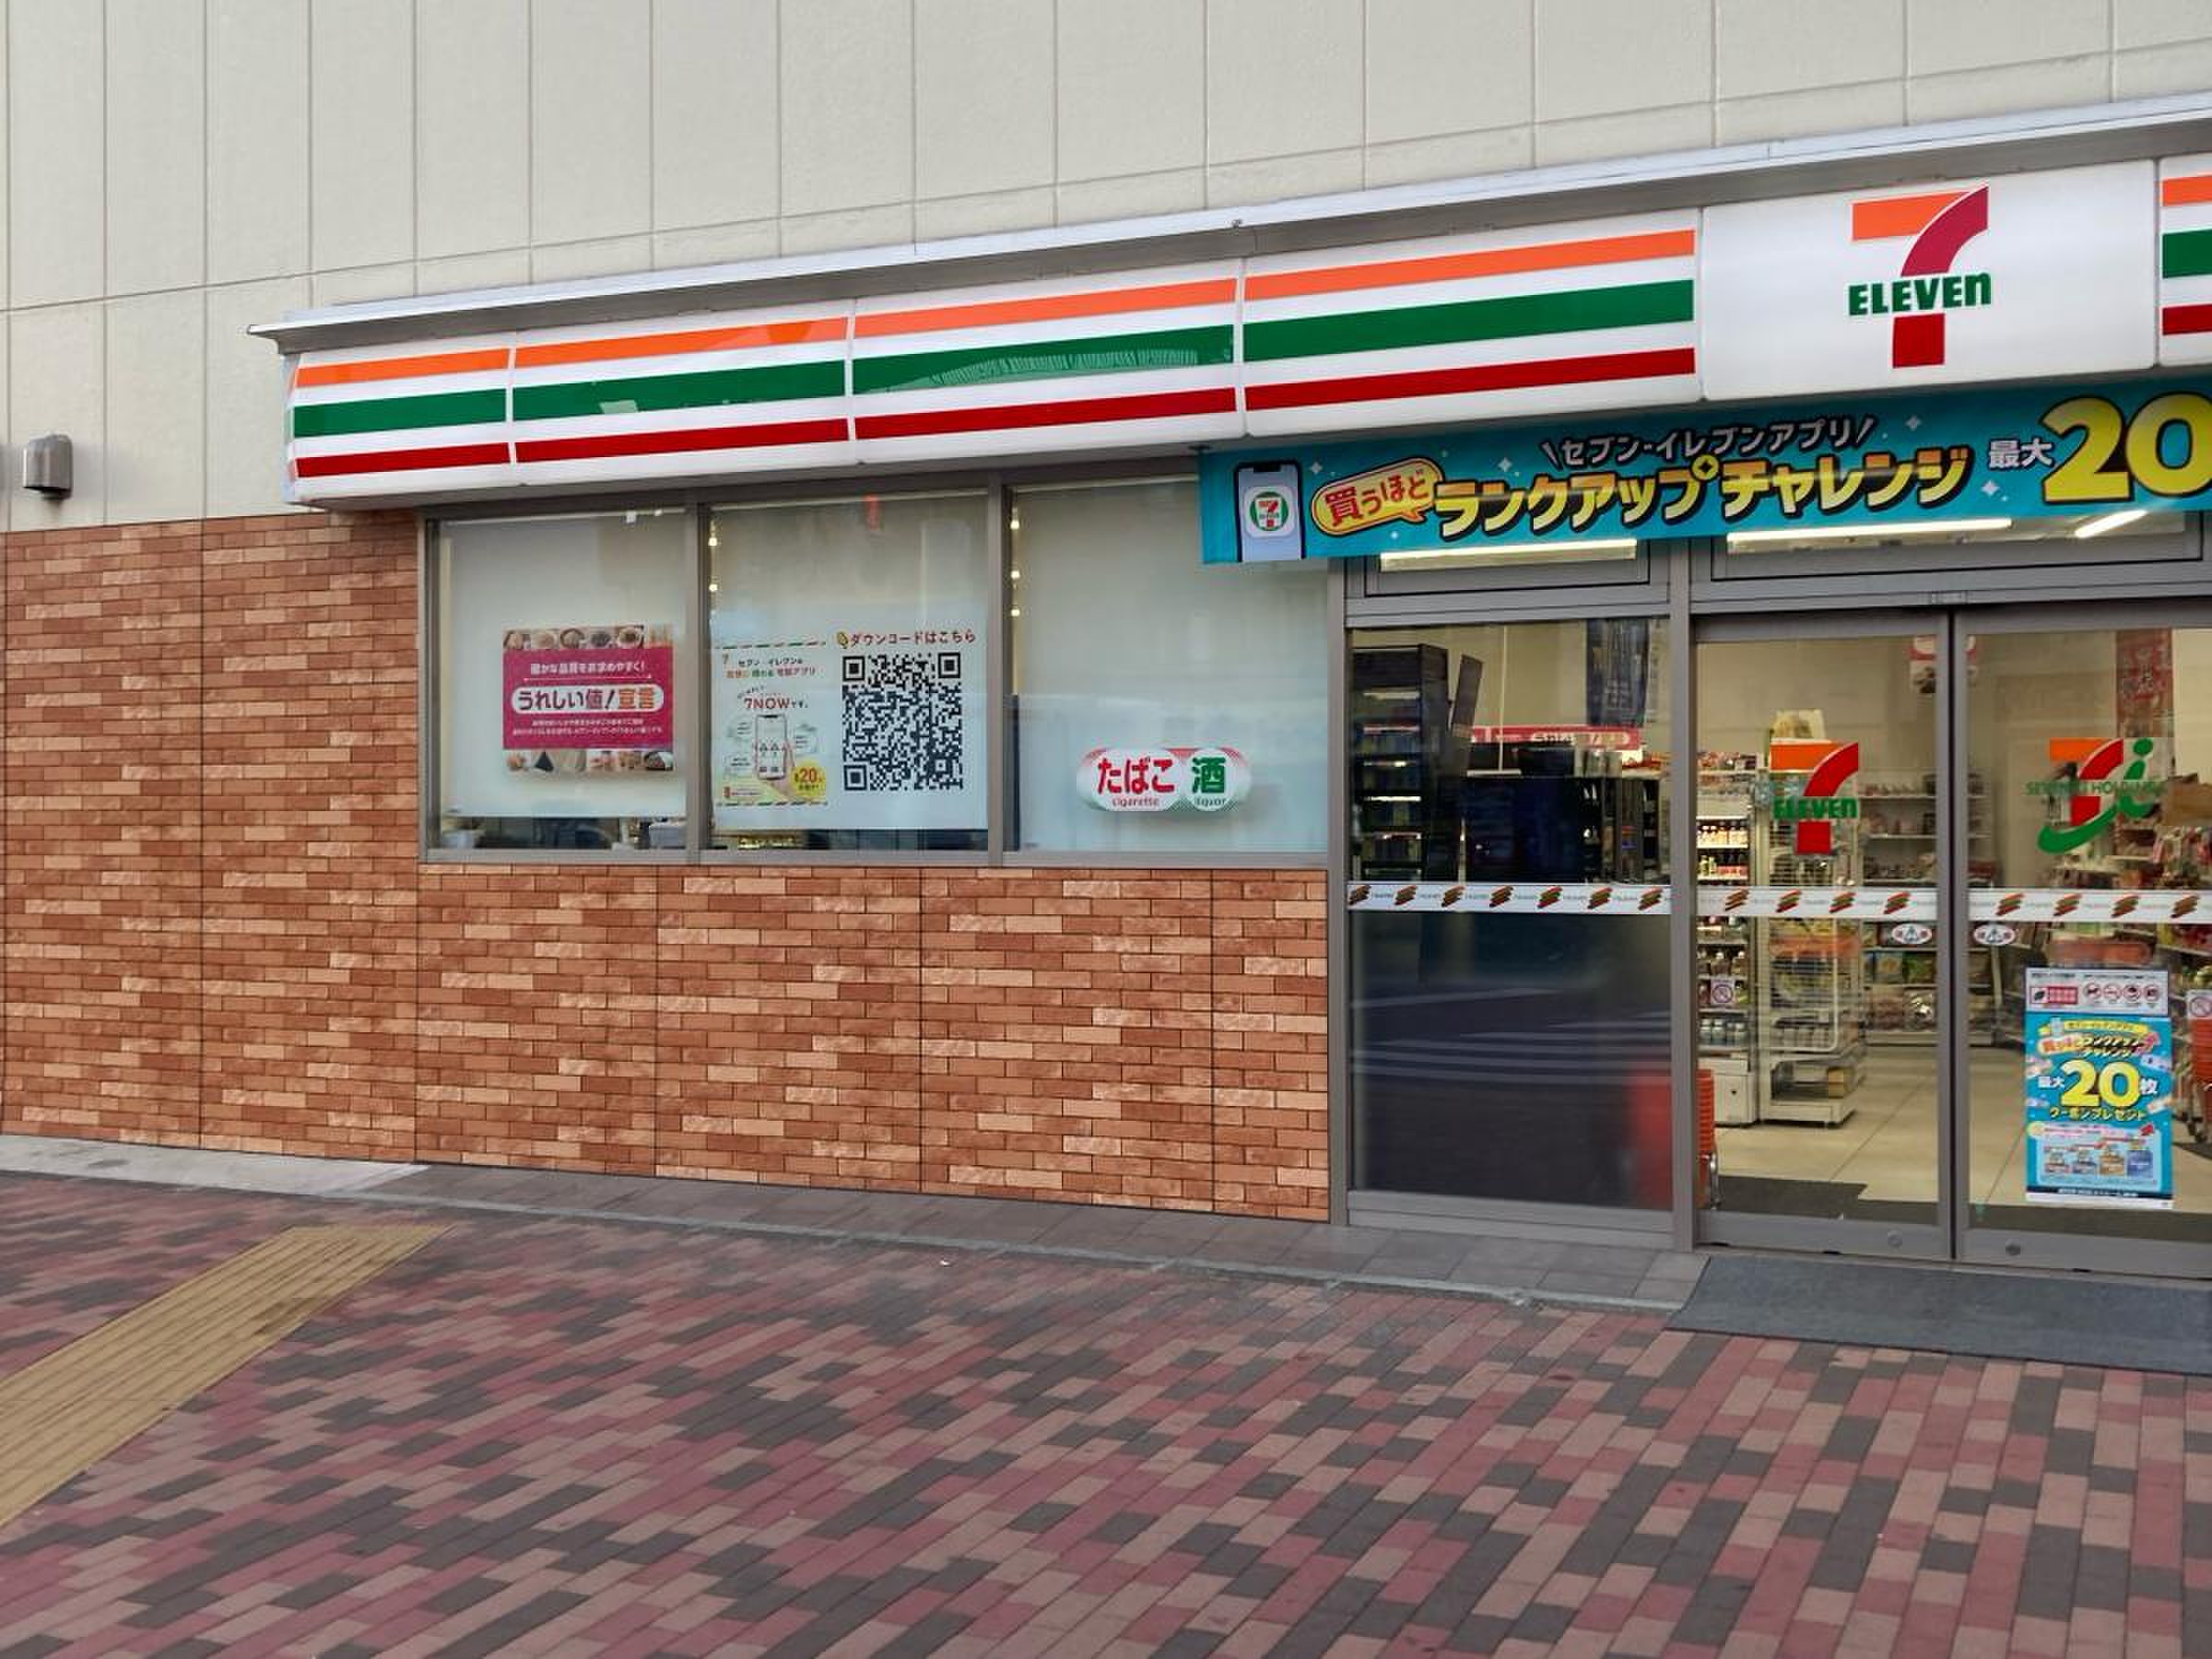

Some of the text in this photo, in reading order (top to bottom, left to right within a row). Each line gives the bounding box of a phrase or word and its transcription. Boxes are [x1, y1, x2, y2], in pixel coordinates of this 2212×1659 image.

[1988, 393, 2212, 503] 最大 20
[1324, 465, 1431, 526] 買うほど
[1434, 447, 1971, 539] ランクアップチャレンジ
[1098, 757, 1226, 794] たばこ 酒
[2060, 1059, 2140, 1107] 20
